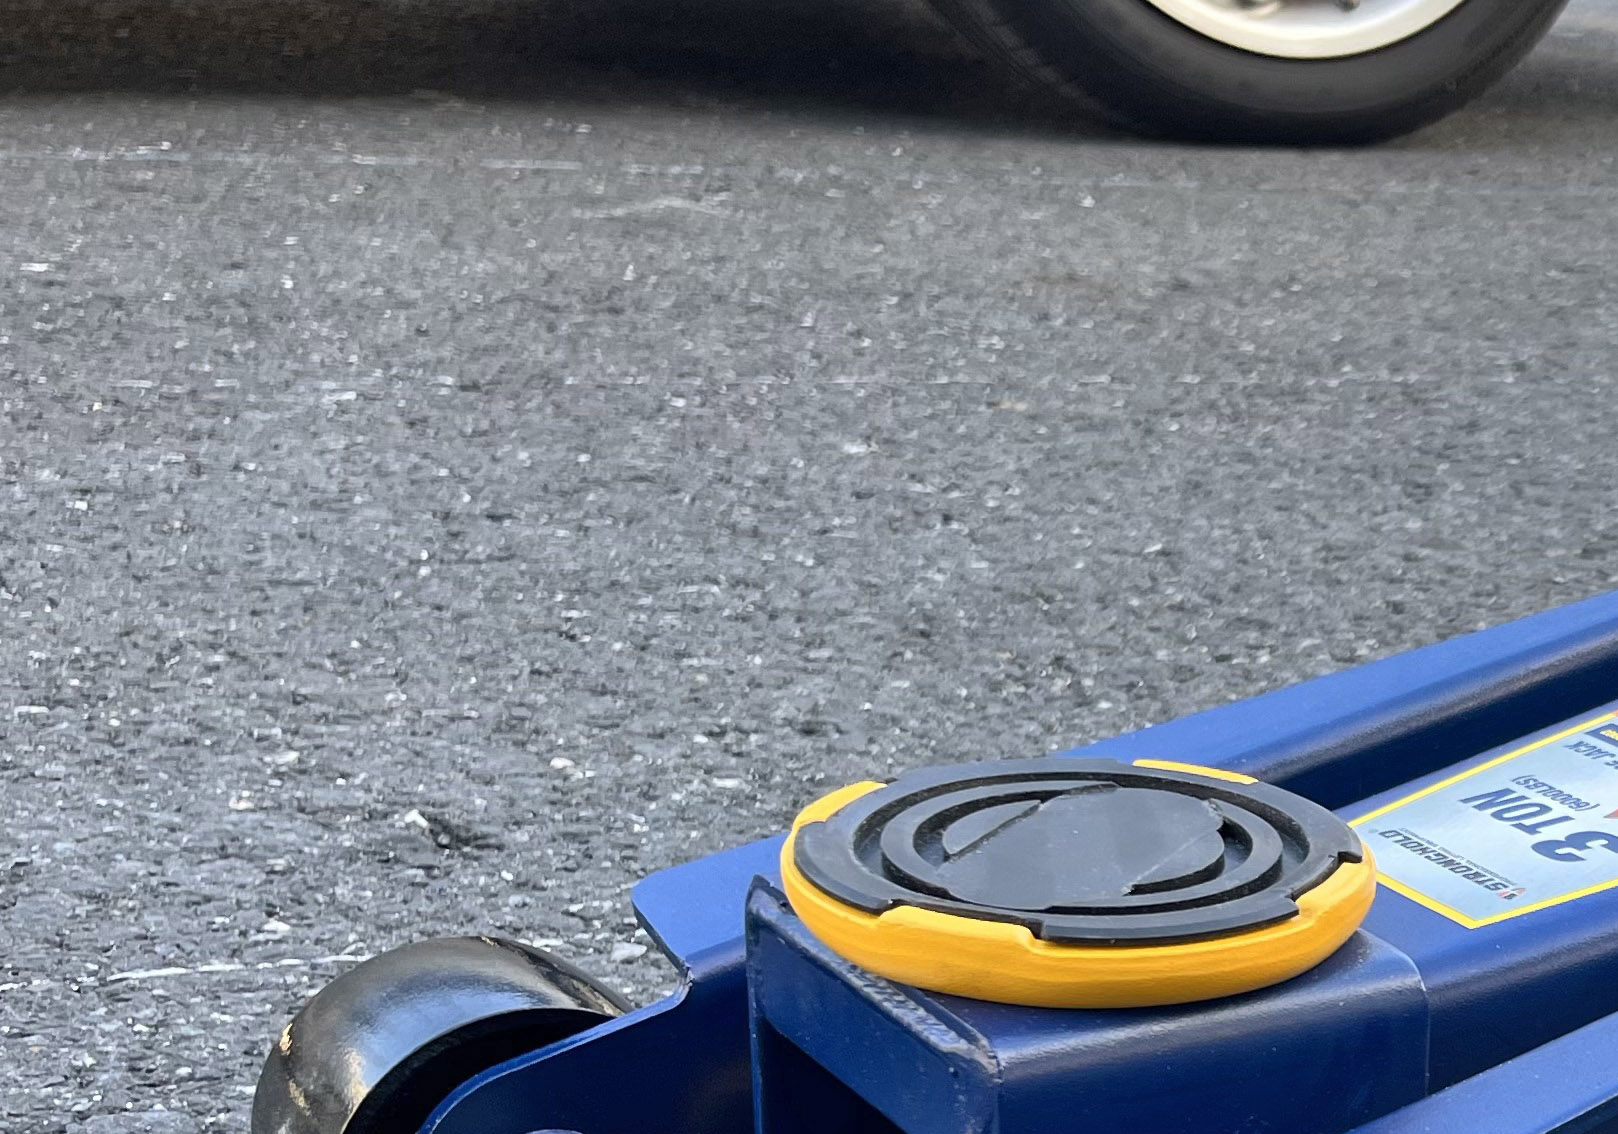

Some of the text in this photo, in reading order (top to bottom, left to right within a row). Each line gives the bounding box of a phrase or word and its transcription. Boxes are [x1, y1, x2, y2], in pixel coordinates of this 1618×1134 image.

[1564, 740, 1616, 760] JACK
[1459, 788, 1573, 834] TON
[1511, 774, 1599, 812] (6000LBS)
[1379, 830, 1508, 891] STRONGHOLD
